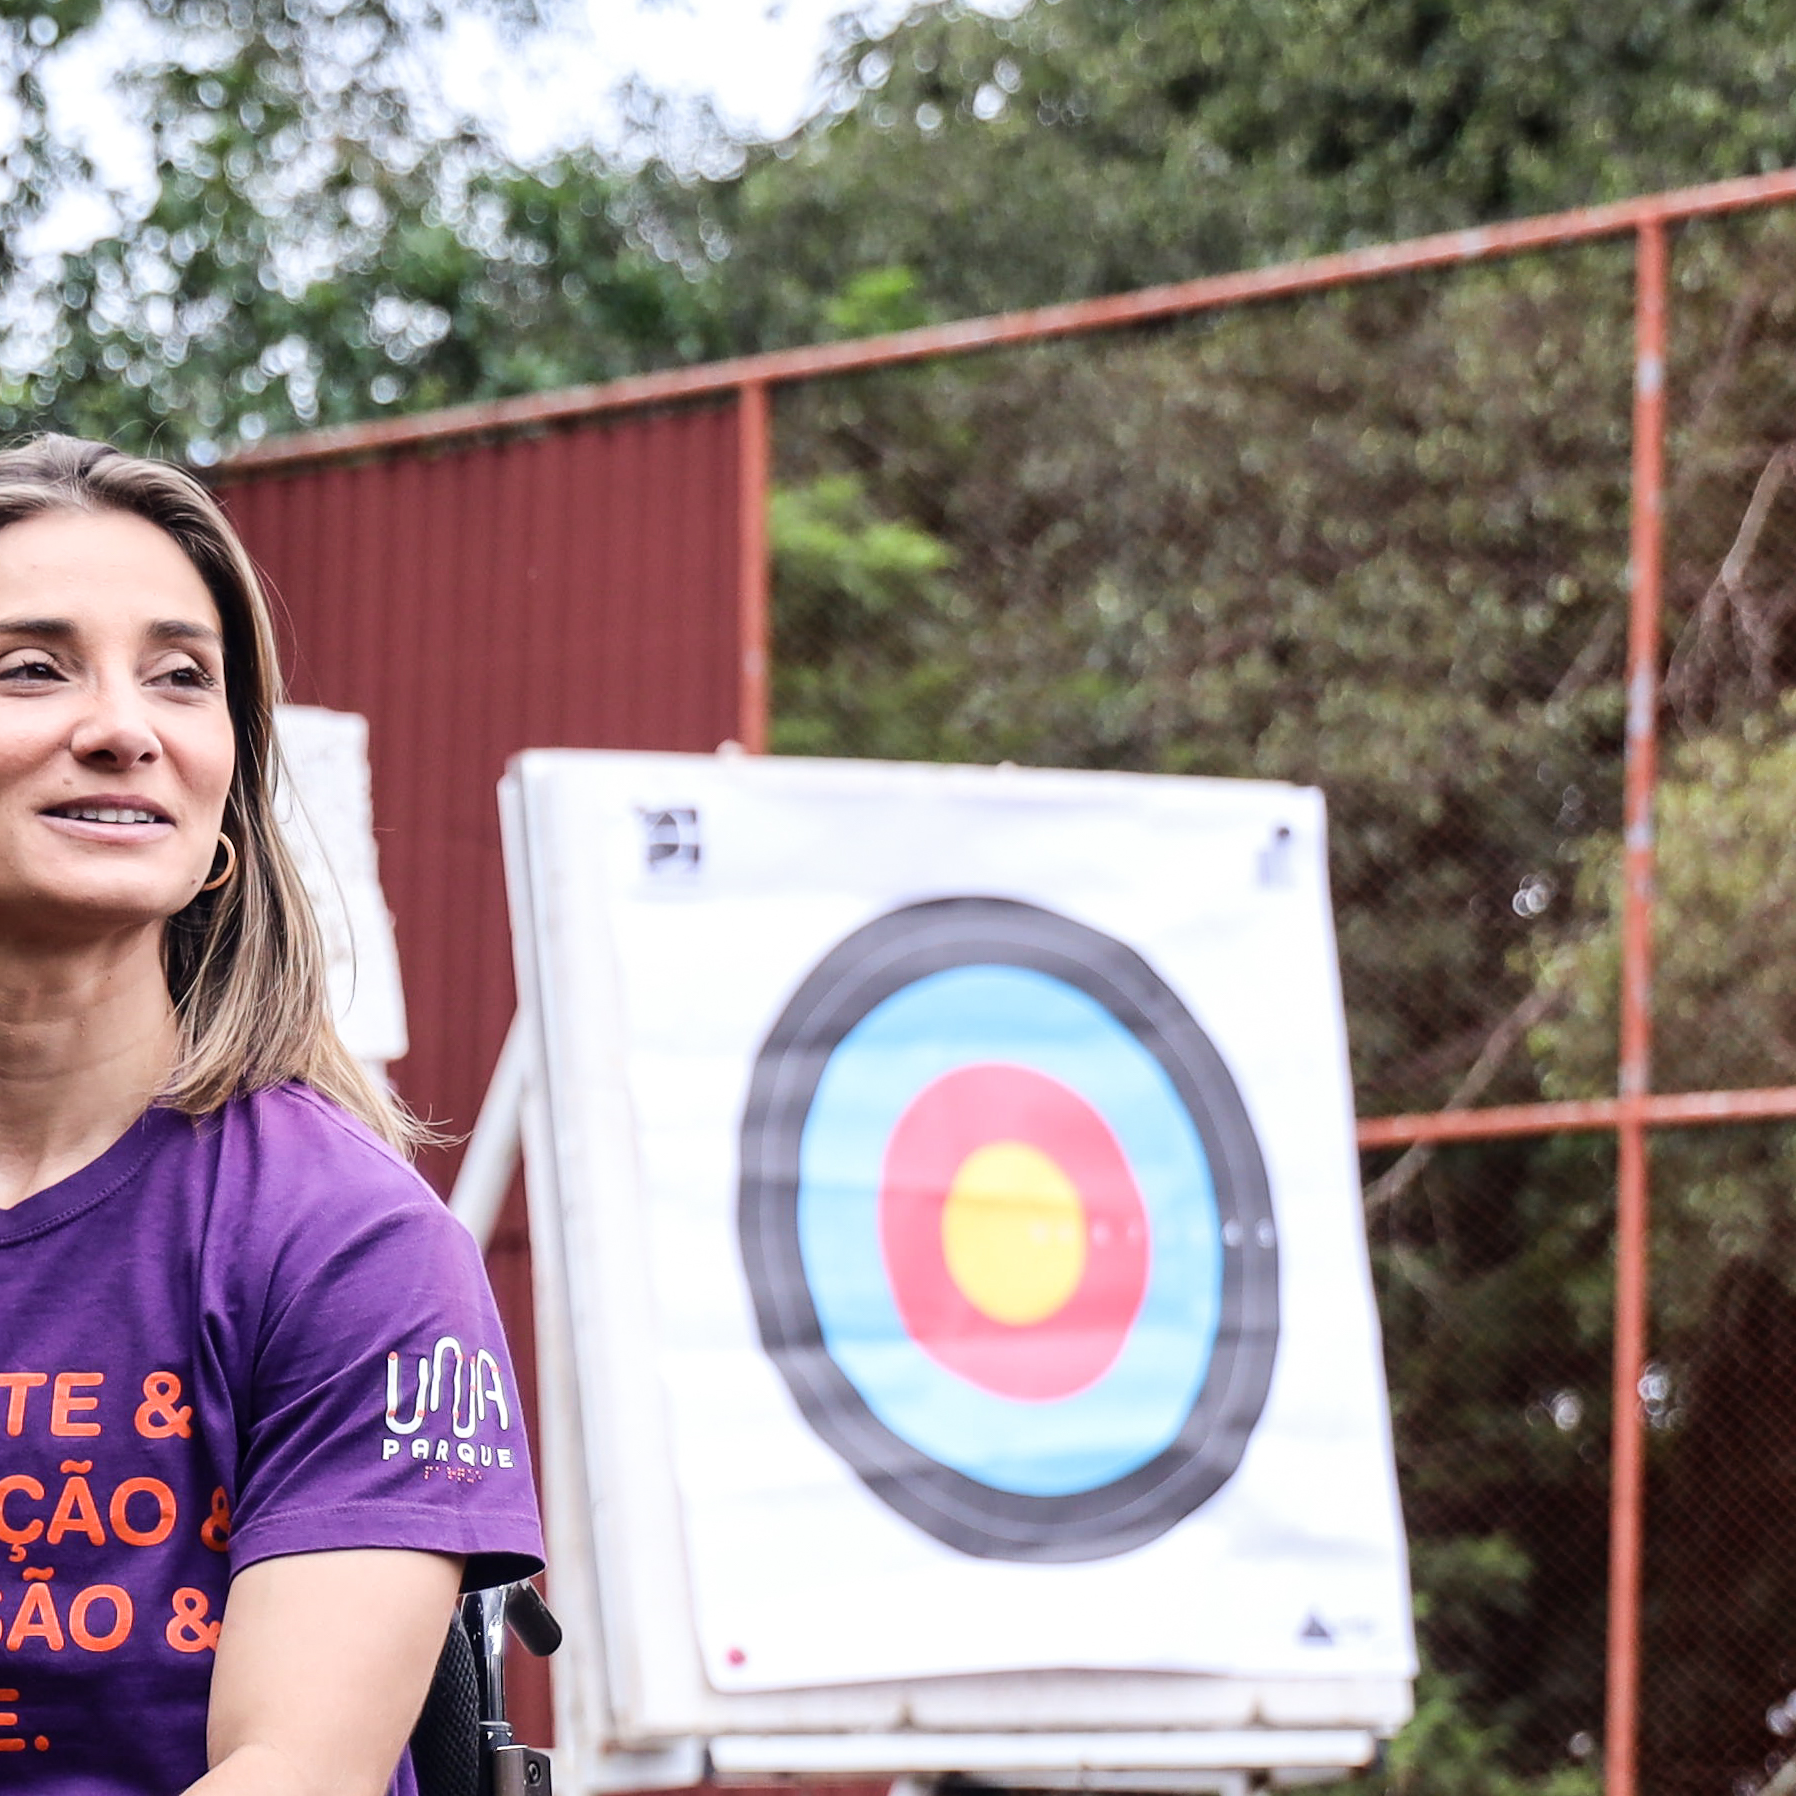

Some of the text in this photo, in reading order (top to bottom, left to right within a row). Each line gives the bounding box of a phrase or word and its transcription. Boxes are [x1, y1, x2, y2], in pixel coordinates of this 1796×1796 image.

[134, 1370, 193, 1440] &
[385, 1336, 509, 1439] UNA
[382, 1438, 514, 1468] PARQUE
[165, 1586, 222, 1653] &
